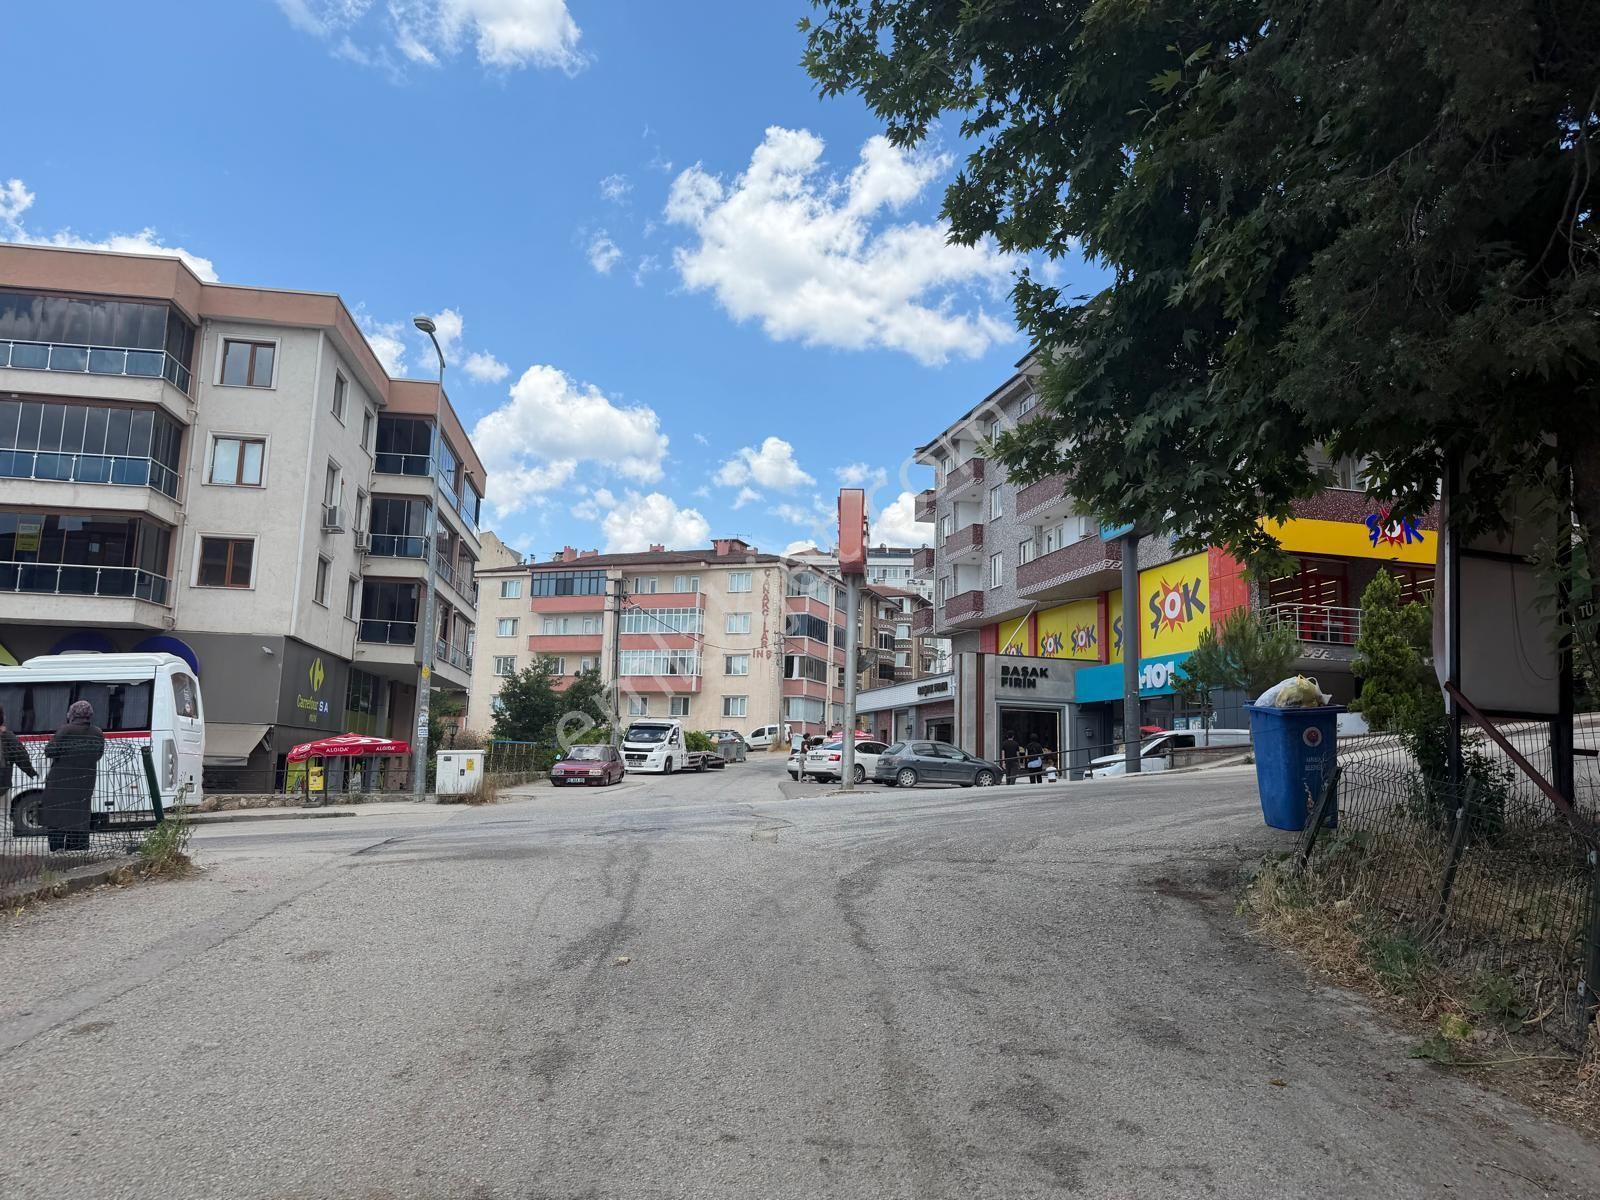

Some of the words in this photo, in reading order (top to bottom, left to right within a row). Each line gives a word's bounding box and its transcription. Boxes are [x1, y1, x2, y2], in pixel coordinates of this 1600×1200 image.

[1148, 576, 1206, 640] ŞOK
[1041, 631, 1064, 657] ŞOK
[1071, 624, 1097, 657] ŞOK
[1001, 665, 1049, 679] BAŞAK
